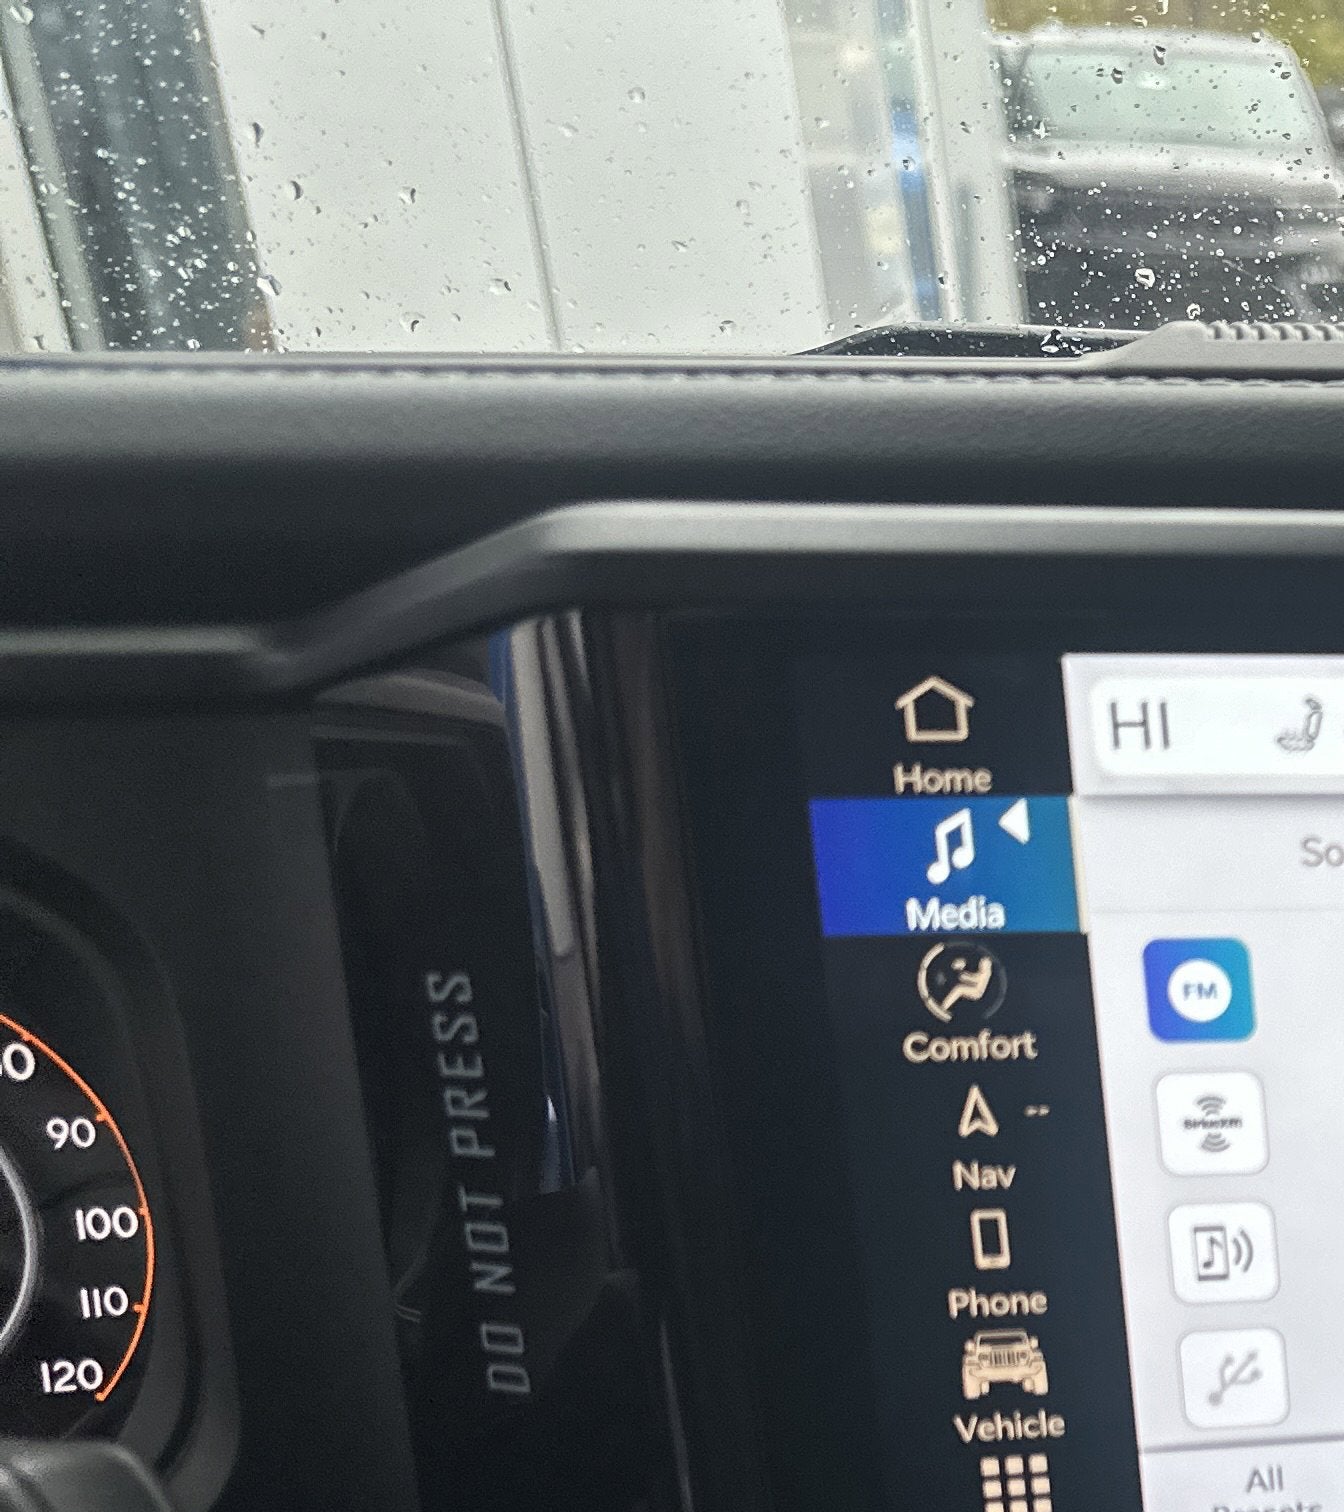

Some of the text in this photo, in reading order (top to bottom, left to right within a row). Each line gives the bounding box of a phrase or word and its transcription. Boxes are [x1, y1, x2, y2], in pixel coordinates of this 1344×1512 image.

[1106, 699, 1172, 751] HI
[893, 761, 993, 795] Home
[905, 895, 1006, 931] Media
[1183, 982, 1218, 1000] FM
[902, 1029, 1038, 1063] Comfort
[45, 1116, 96, 1150] 90
[426, 969, 532, 1396] DO NOT PRESS
[951, 1159, 1016, 1192] Nav
[74, 1206, 140, 1242] 100
[79, 1285, 130, 1320] 110
[947, 1287, 1048, 1319] Phone
[40, 1358, 104, 1394] 120
[953, 1408, 1066, 1444] Vehicle
[1245, 1464, 1285, 1493] All
